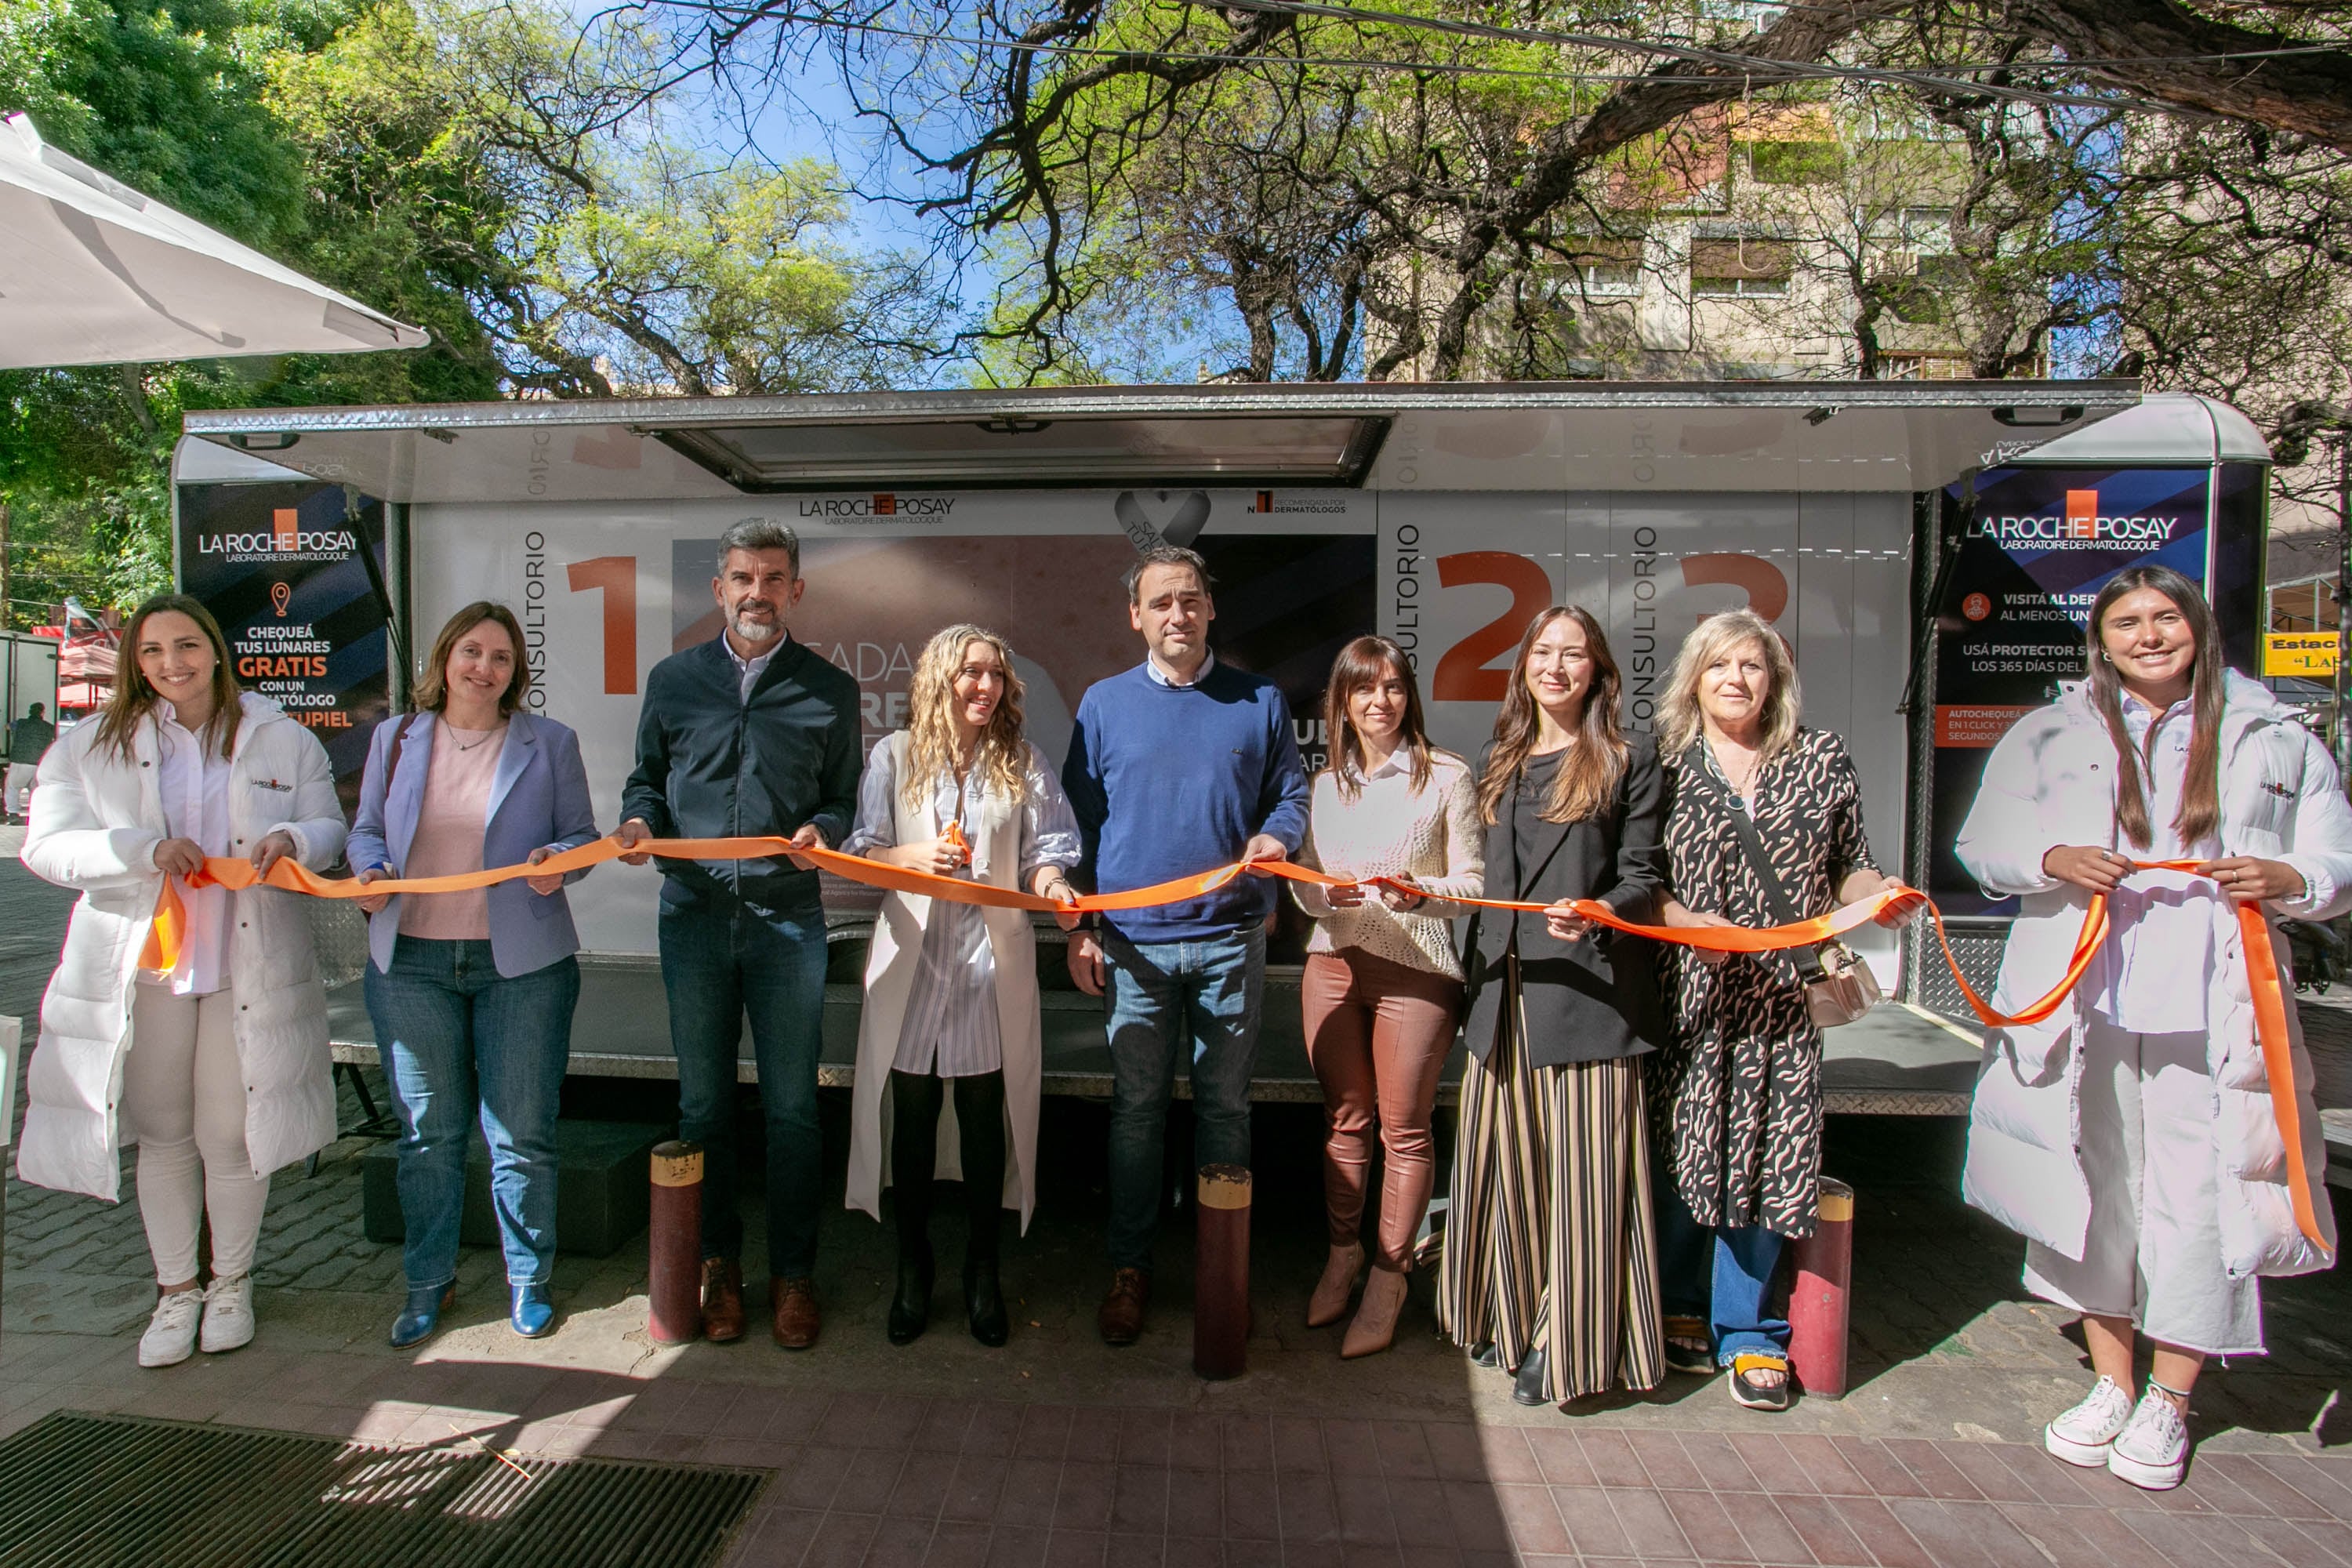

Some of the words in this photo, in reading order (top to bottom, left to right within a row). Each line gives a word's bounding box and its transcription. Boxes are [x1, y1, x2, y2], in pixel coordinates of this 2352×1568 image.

[800, 500, 822, 517] LA
[826, 499, 890, 516] ROCHE
[894, 498, 956, 515] POSAY
[876, 516, 944, 524] DERMATOLOGIQUE
[1967, 517, 1998, 538] LA
[2001, 517, 2090, 539] ROCHE
[2094, 517, 2177, 539] POSAY
[200, 534, 224, 554] LA
[226, 532, 295, 553] ROCHE
[297, 531, 357, 551] POSAY
[2001, 540, 2069, 550] LABORATOIRE
[2069, 540, 2160, 551] DERMATOLOGIQUE
[226, 552, 279, 562] LABORATOIRE
[279, 551, 350, 561] DERMATOLOGIQUE
[2003, 592, 2047, 604] VISITÁ
[2049, 594, 2067, 604] AL
[2000, 611, 2016, 620] AL
[2019, 611, 2067, 621] MENOS
[525, 532, 546, 717] ONSULTORIO
[567, 556, 637, 695] 1
[1432, 550, 1552, 702] 2
[248, 623, 314, 641] CHEQUEÁ
[235, 642, 263, 654] TUS
[265, 641, 331, 653] LUNARES
[1963, 643, 1990, 655] USÁ
[1991, 645, 2074, 656] PROTECTOR
[238, 656, 327, 677] GRATIS
[804, 642, 914, 682] ADA
[1972, 661, 1997, 672] LOS
[1999, 662, 2023, 672] 365
[2025, 659, 2055, 672] DÍAS
[2057, 662, 2083, 672] DEL
[260, 681, 285, 691] CON
[287, 681, 305, 691] UN
[1948, 709, 2021, 720] AUTOCHEQUEÁ
[1949, 720, 1962, 729] EN
[1969, 720, 1995, 729] CLICK
[1948, 732, 2000, 741] SEGUNDOS
